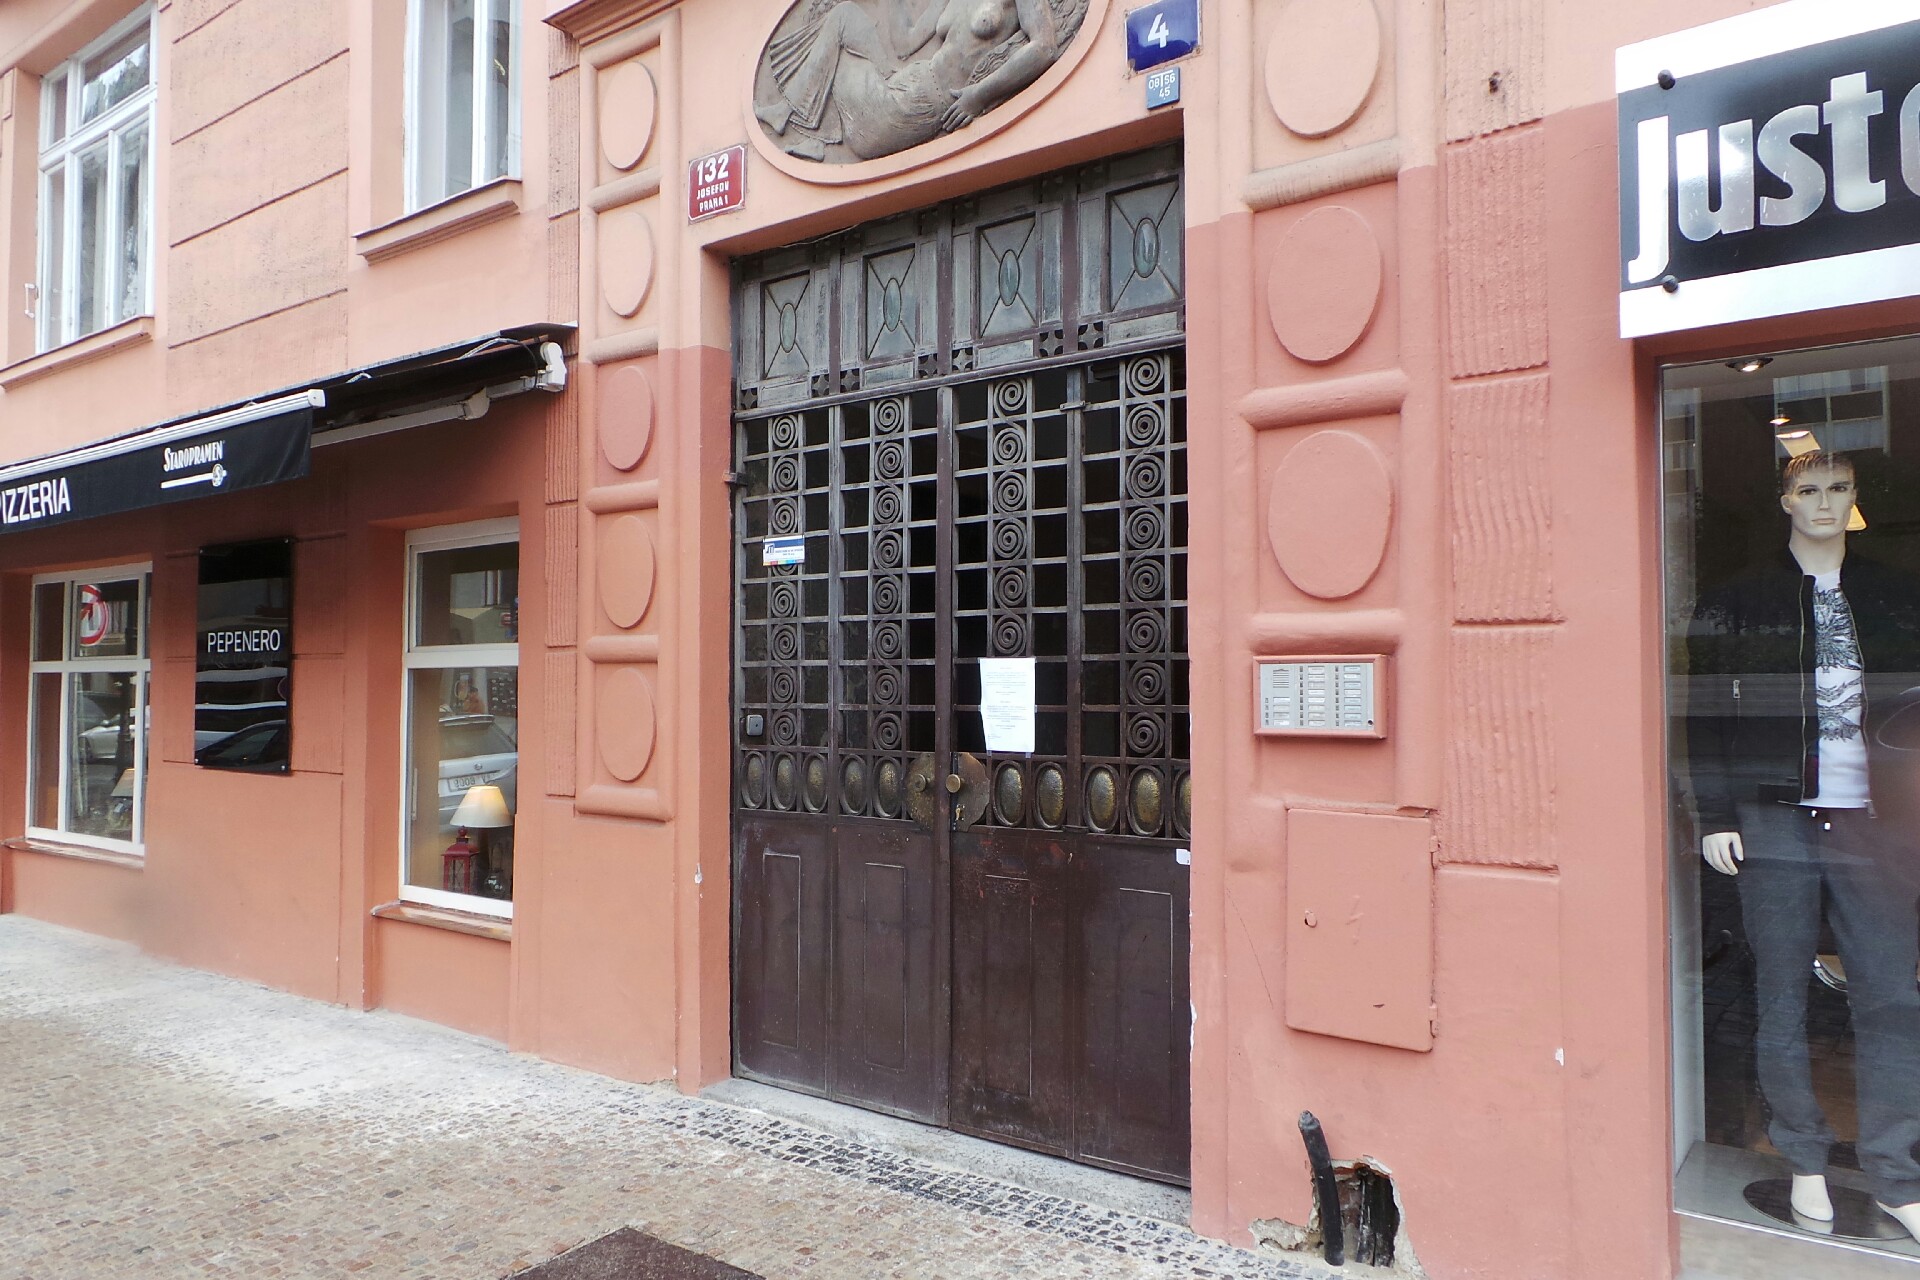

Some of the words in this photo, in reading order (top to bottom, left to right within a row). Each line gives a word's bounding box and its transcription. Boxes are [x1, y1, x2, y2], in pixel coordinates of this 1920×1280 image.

[1147, 12, 1170, 48] 4
[697, 153, 729, 186] 132
[696, 181, 730, 200] JOSEFOV
[699, 196, 724, 213] PRAHA
[163, 440, 223, 472] STAROPRAMEN
[0, 477, 71, 524] IZZERIA
[207, 629, 281, 653] PEPENERO
